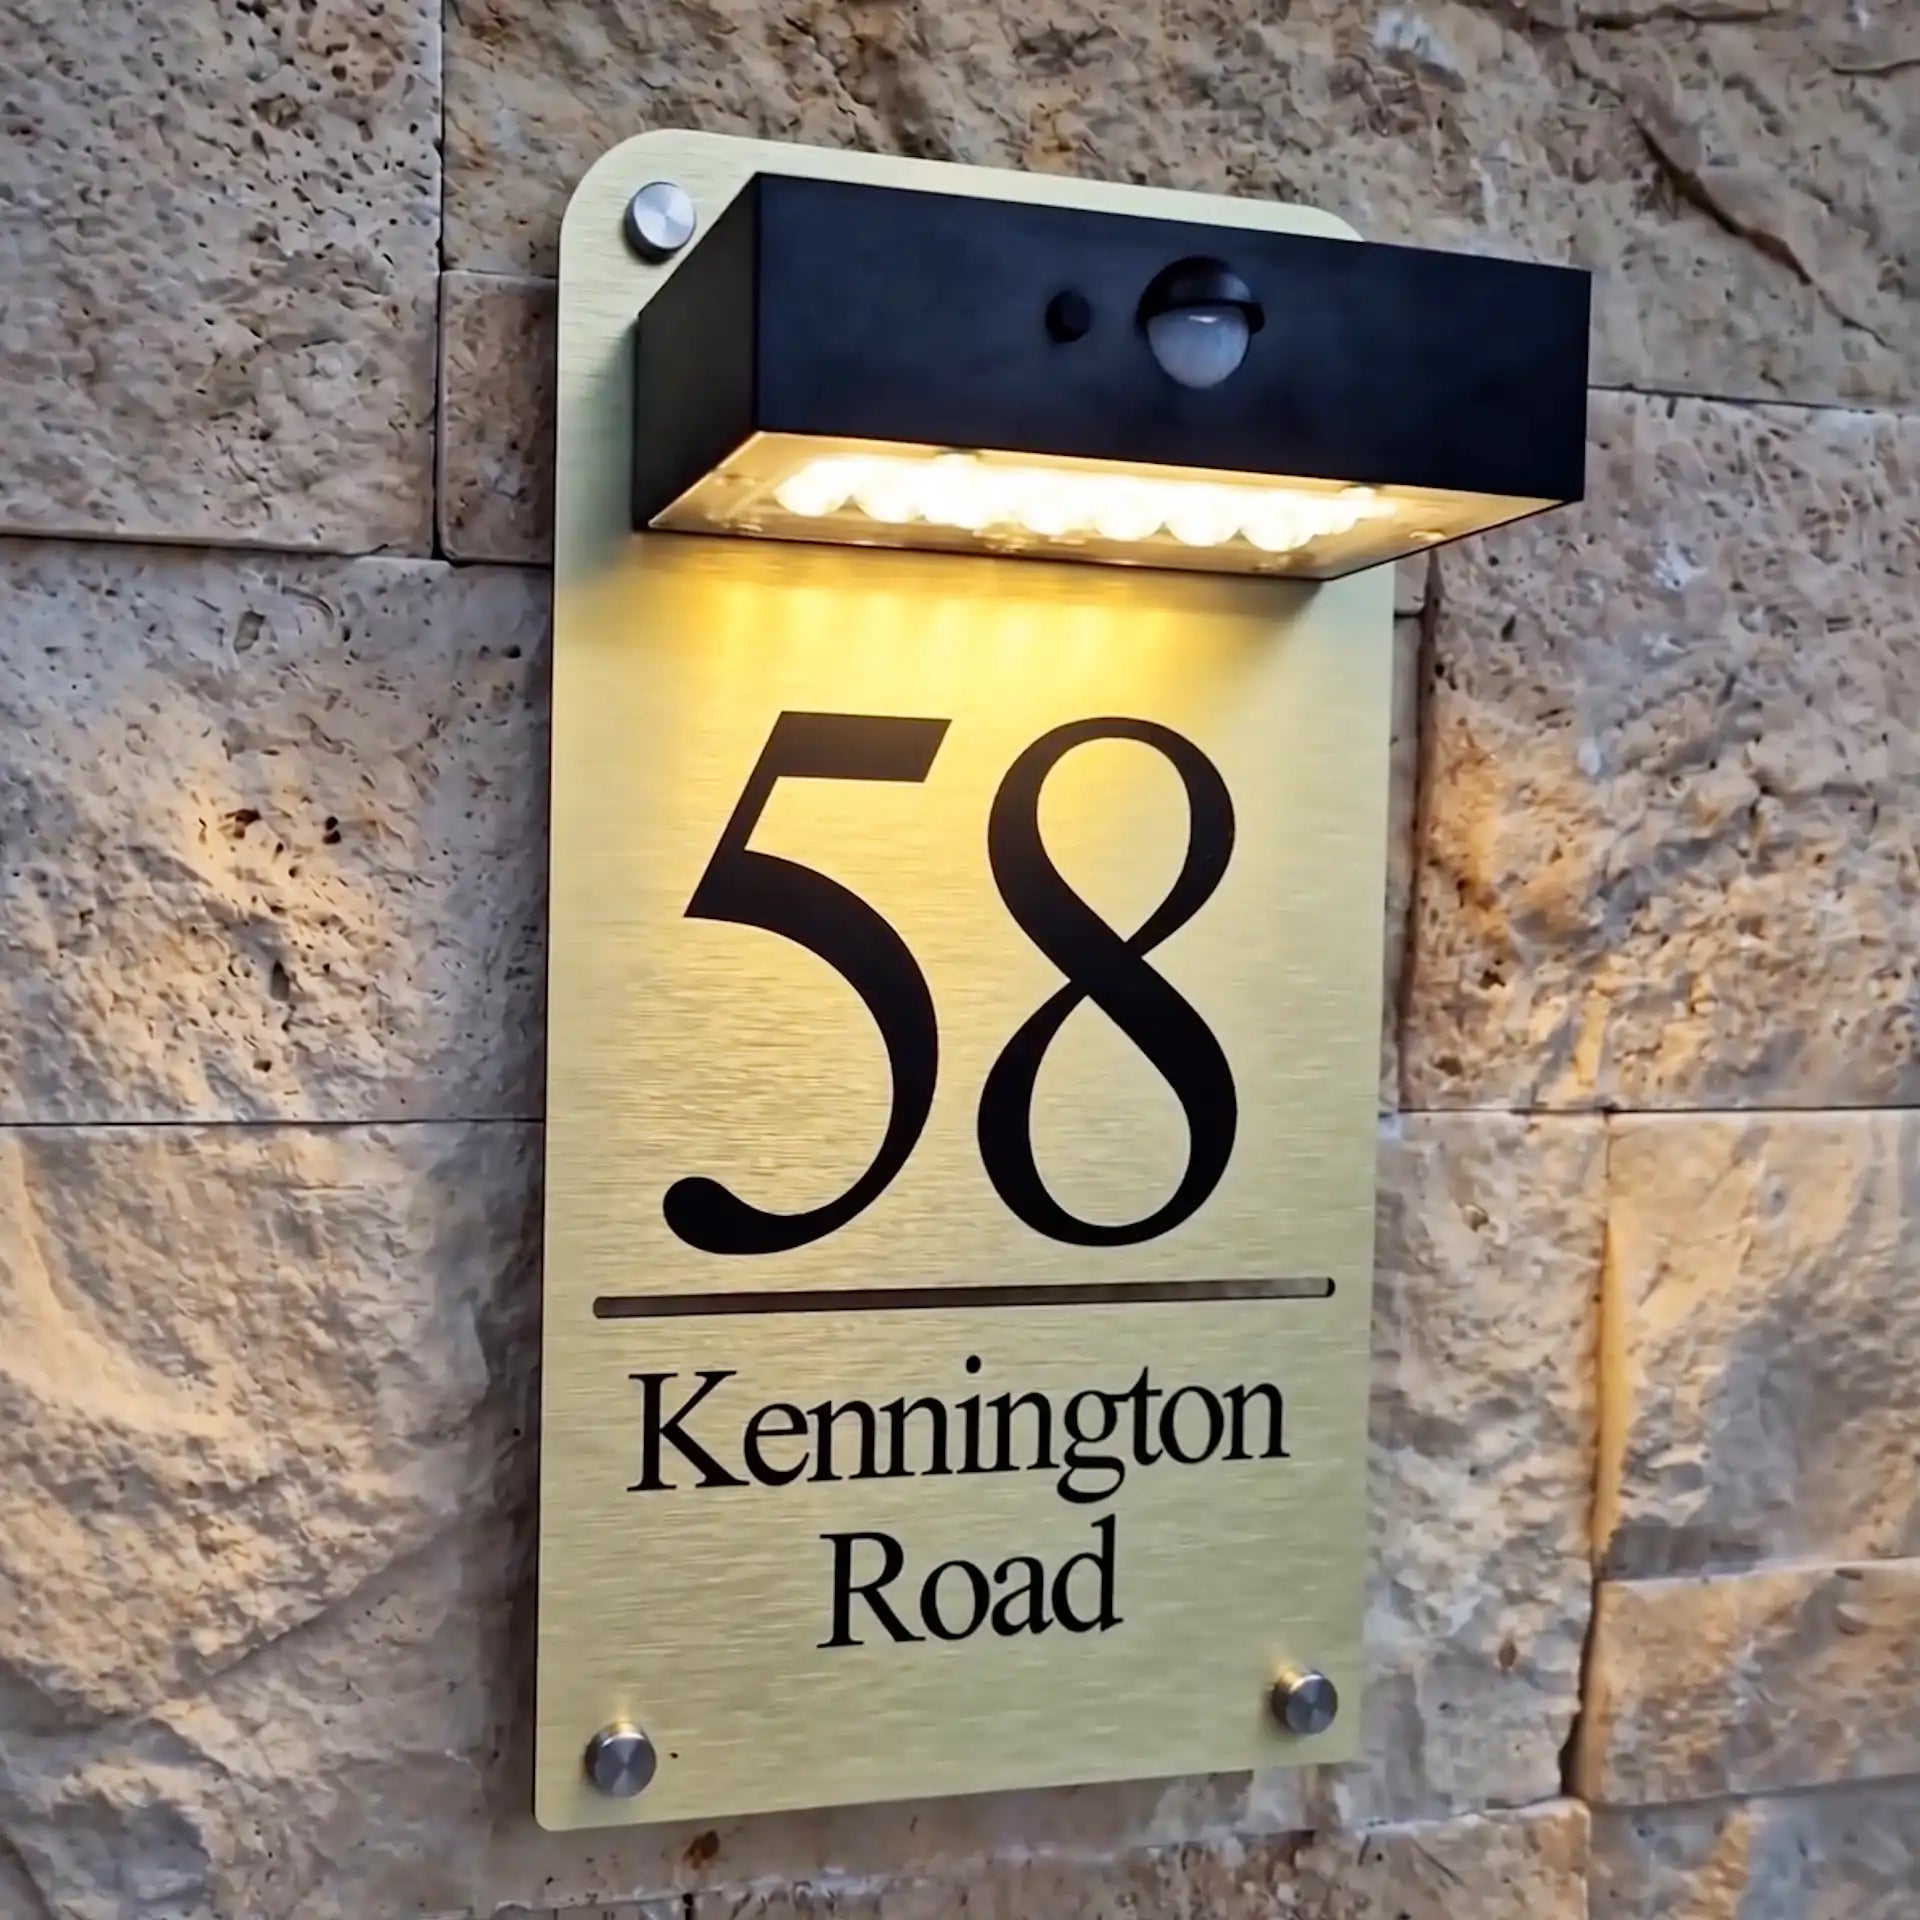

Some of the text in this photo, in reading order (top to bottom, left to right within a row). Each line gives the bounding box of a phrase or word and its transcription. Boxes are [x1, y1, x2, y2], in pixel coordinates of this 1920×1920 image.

[662, 711, 1238, 1256] 58
[626, 1354, 1291, 1505] Kennington
[816, 1513, 1124, 1649] Road
